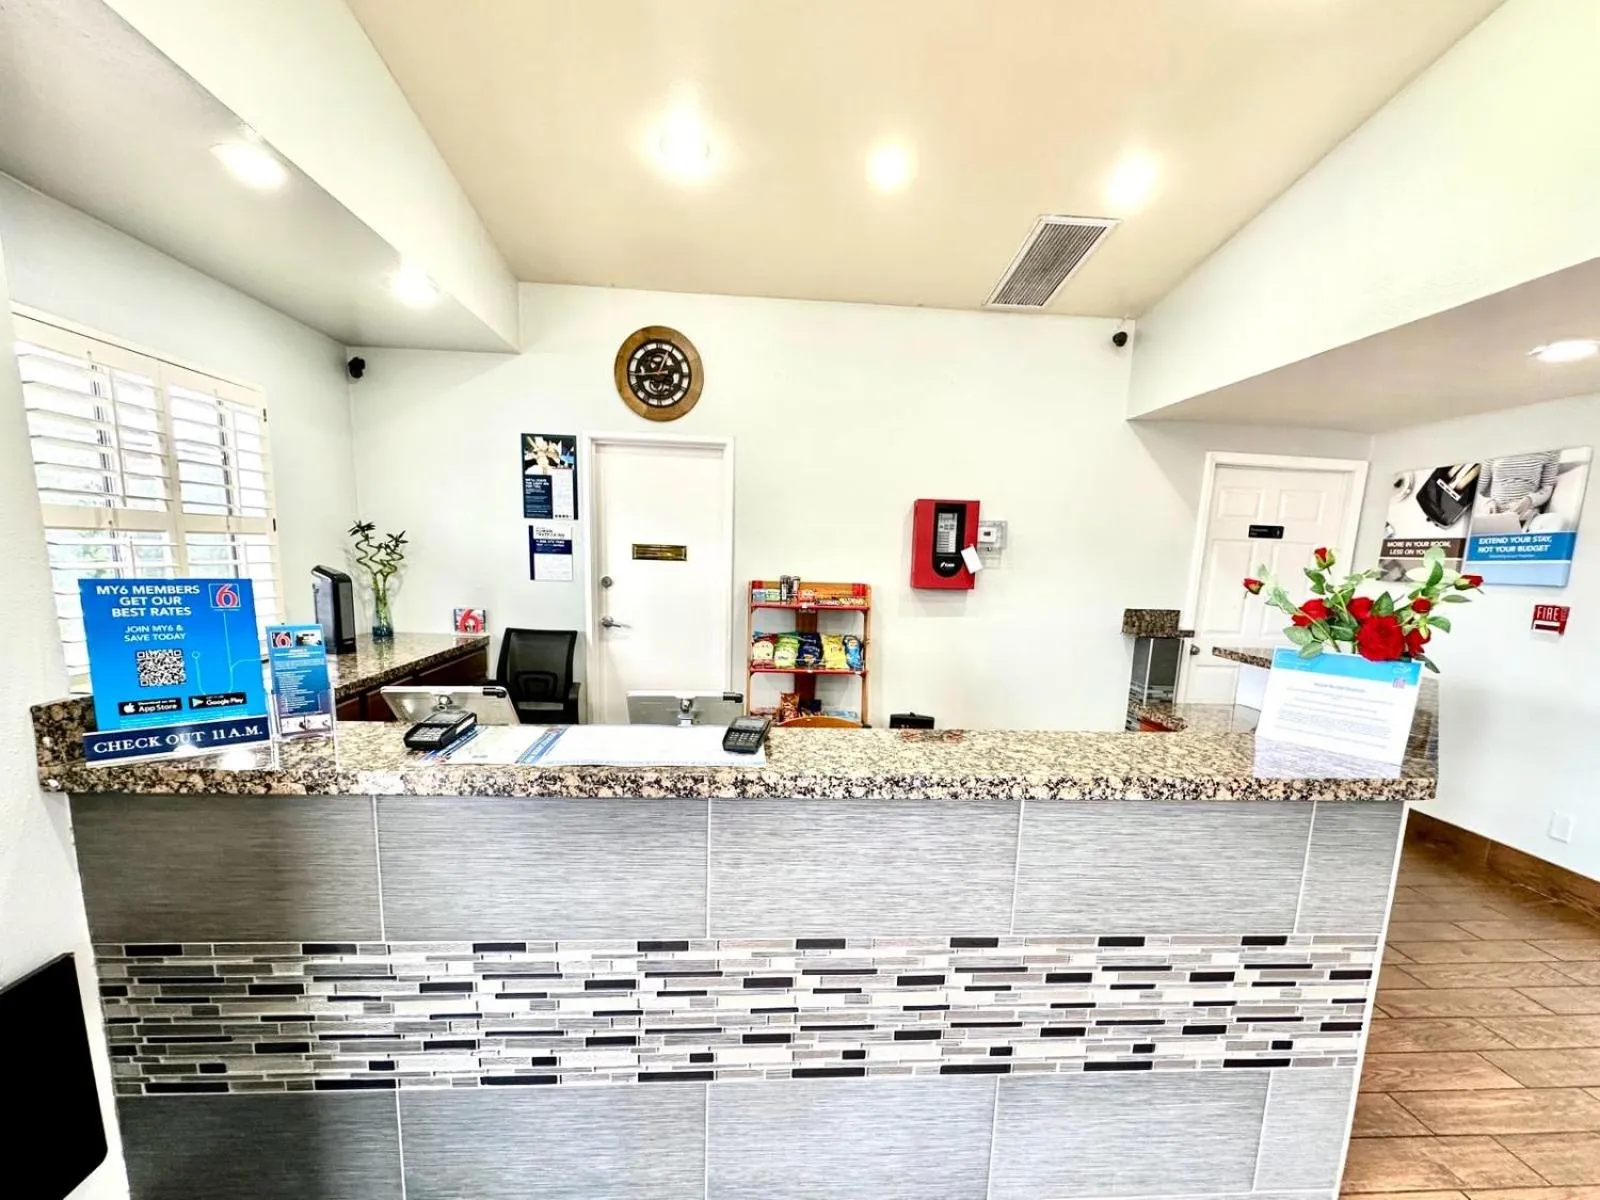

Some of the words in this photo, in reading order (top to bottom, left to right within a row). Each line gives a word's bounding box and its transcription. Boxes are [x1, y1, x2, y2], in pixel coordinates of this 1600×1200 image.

[96, 585, 128, 595] MY6
[132, 585, 200, 594] MEMBERS
[215, 583, 239, 608] 6
[120, 597, 147, 606] GET
[151, 596, 182, 605] OUR
[112, 608, 146, 617] BEST
[150, 607, 192, 616] RATES
[1537, 606, 1560, 621] FIRE
[125, 625, 149, 633] JOIN
[152, 624, 173, 632] MY6
[124, 634, 150, 642] SAVE
[153, 633, 186, 641] TODAY
[206, 698, 229, 706] Google
[230, 697, 244, 705] Play
[139, 705, 155, 713] App
[93, 736, 162, 754] CHECK
[165, 731, 205, 745] OUT
[212, 730, 225, 740] 11
[228, 725, 263, 739] A.M.
